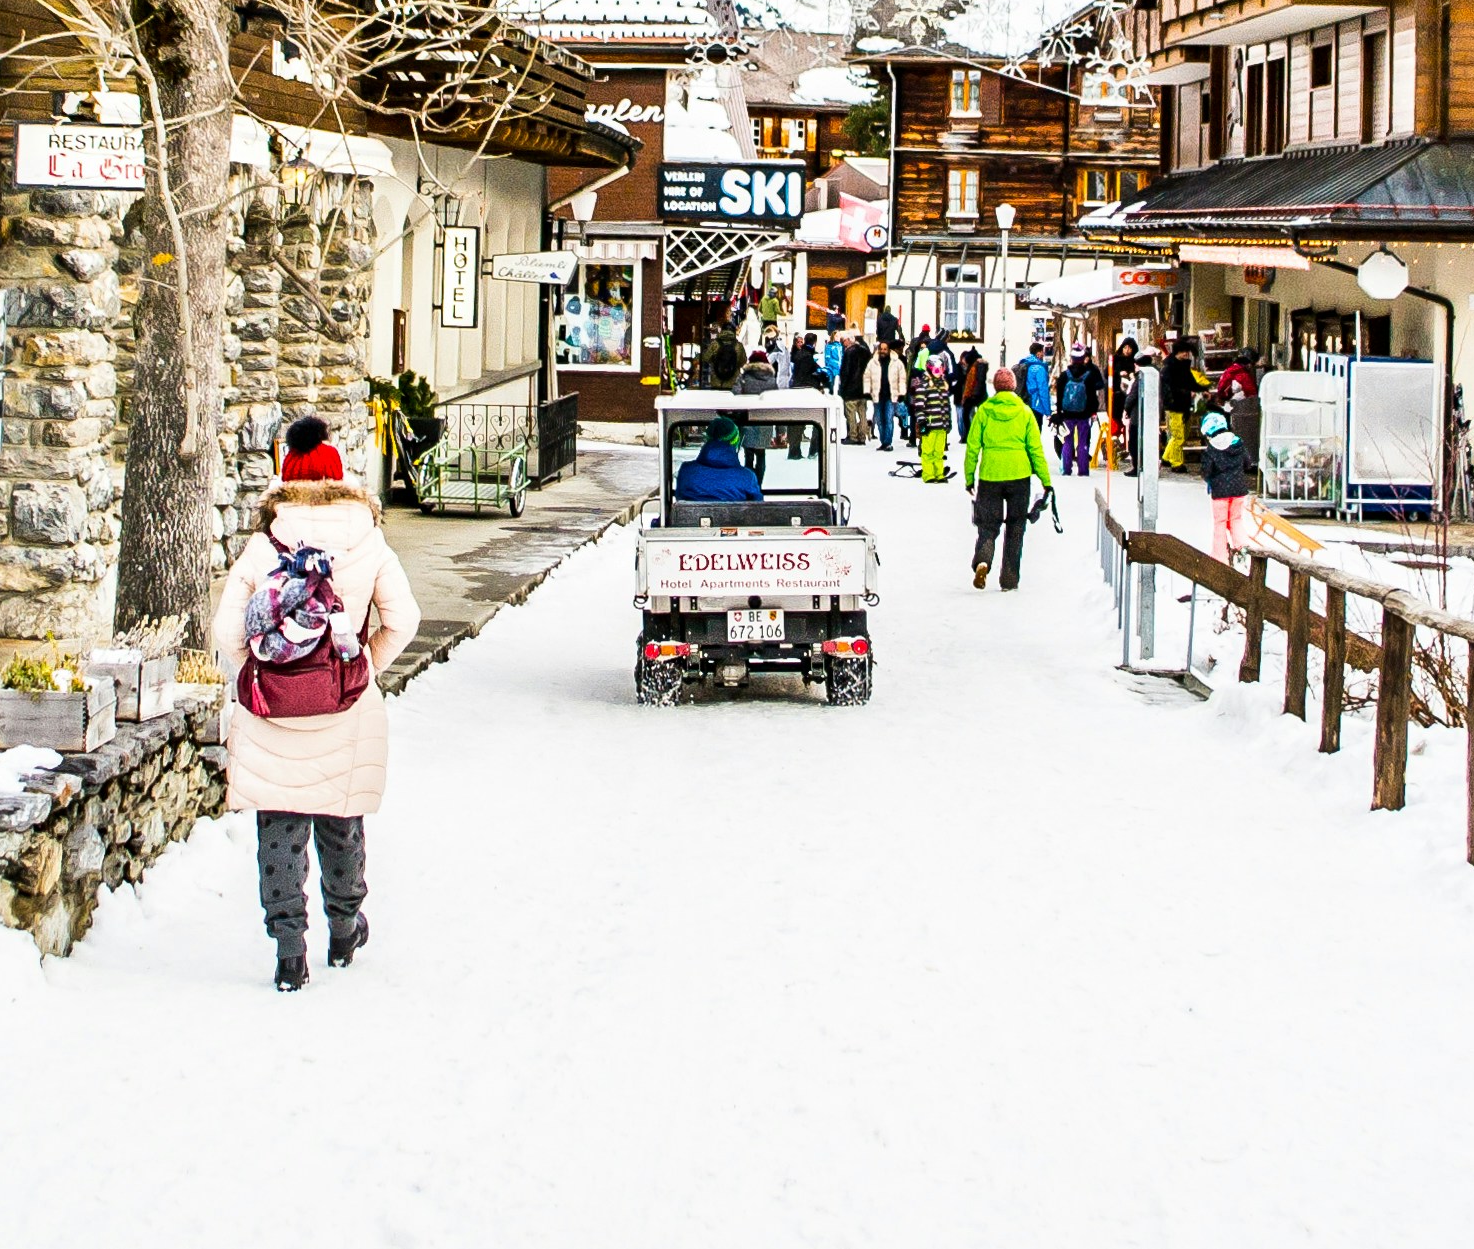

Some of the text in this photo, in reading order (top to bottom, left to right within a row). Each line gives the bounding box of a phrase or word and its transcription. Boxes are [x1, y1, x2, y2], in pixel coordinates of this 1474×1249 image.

[49, 152, 83, 178] La
[664, 171, 705, 183] VERLEIH
[664, 186, 704, 198] HIRE OF
[719, 169, 802, 217] SKI
[664, 200, 717, 212] LOCATION
[452, 236, 468, 320] HOTEL
[679, 553, 811, 572] EDELWEISS
[660, 578, 841, 590] Hotel Apartments Restaurant
[749, 611, 763, 622] BE
[730, 624, 782, 640] 672 106
